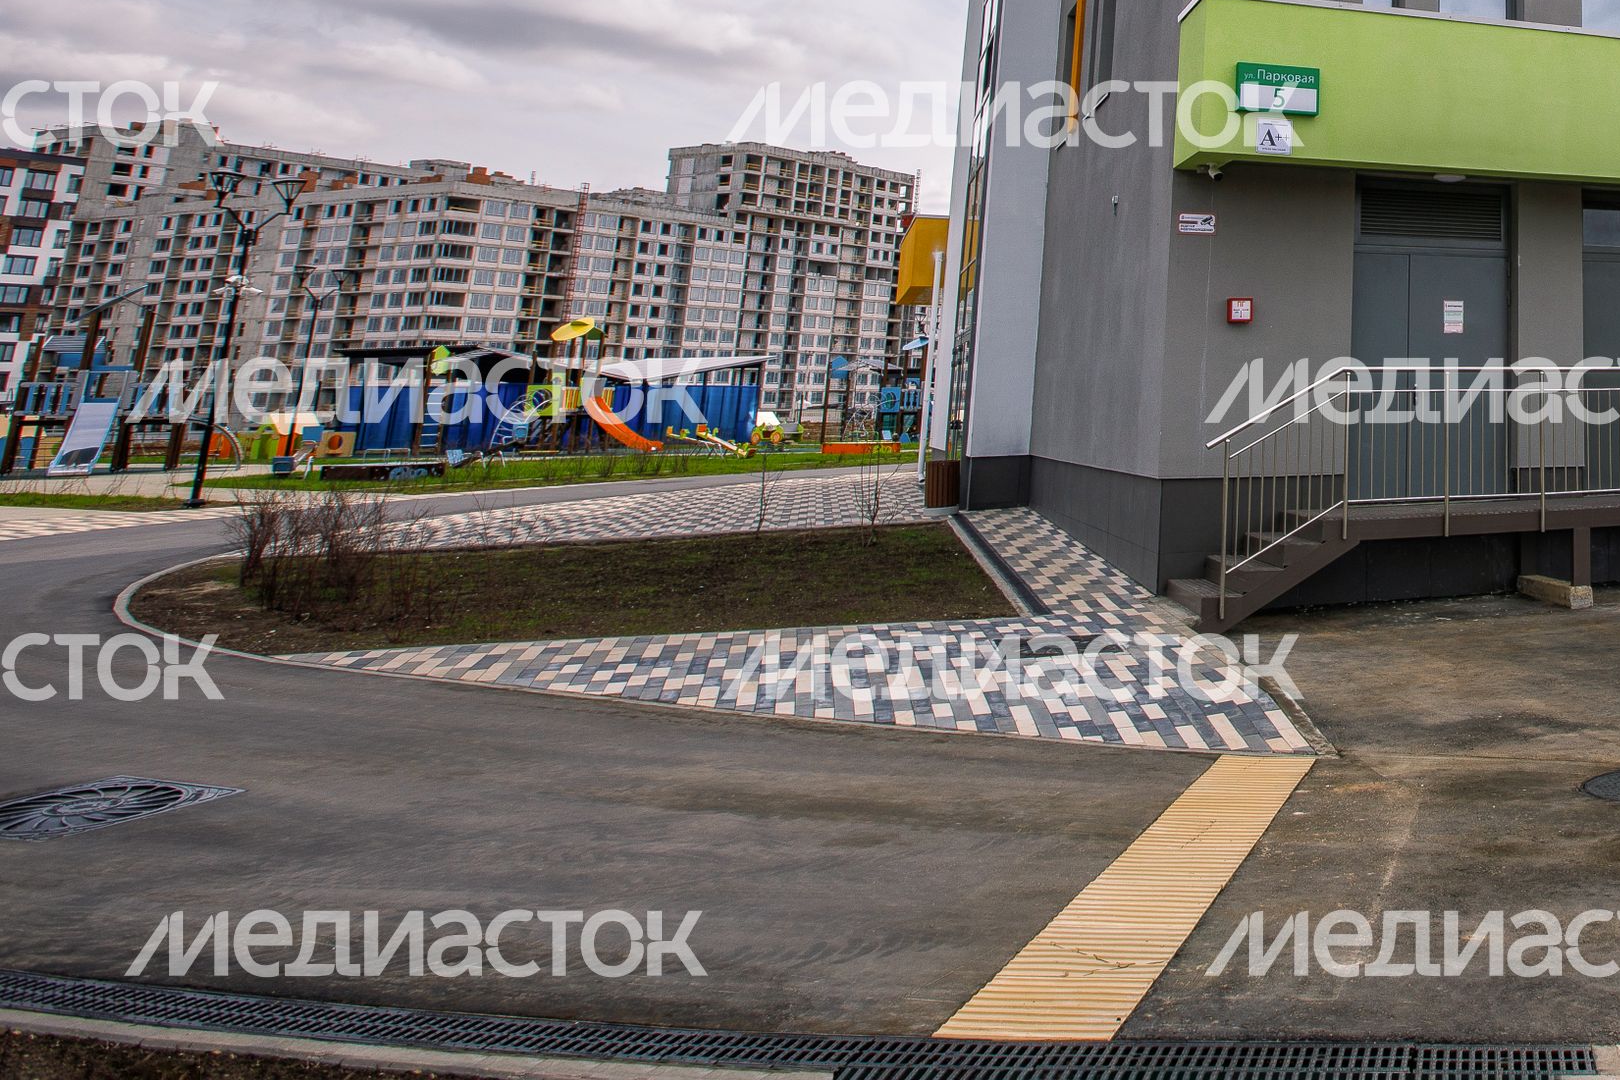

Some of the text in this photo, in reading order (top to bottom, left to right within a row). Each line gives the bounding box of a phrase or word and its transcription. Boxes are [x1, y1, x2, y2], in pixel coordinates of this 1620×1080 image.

[1244, 68, 1315, 84] ул. Парковая
[1273, 87, 1286, 108] 5
